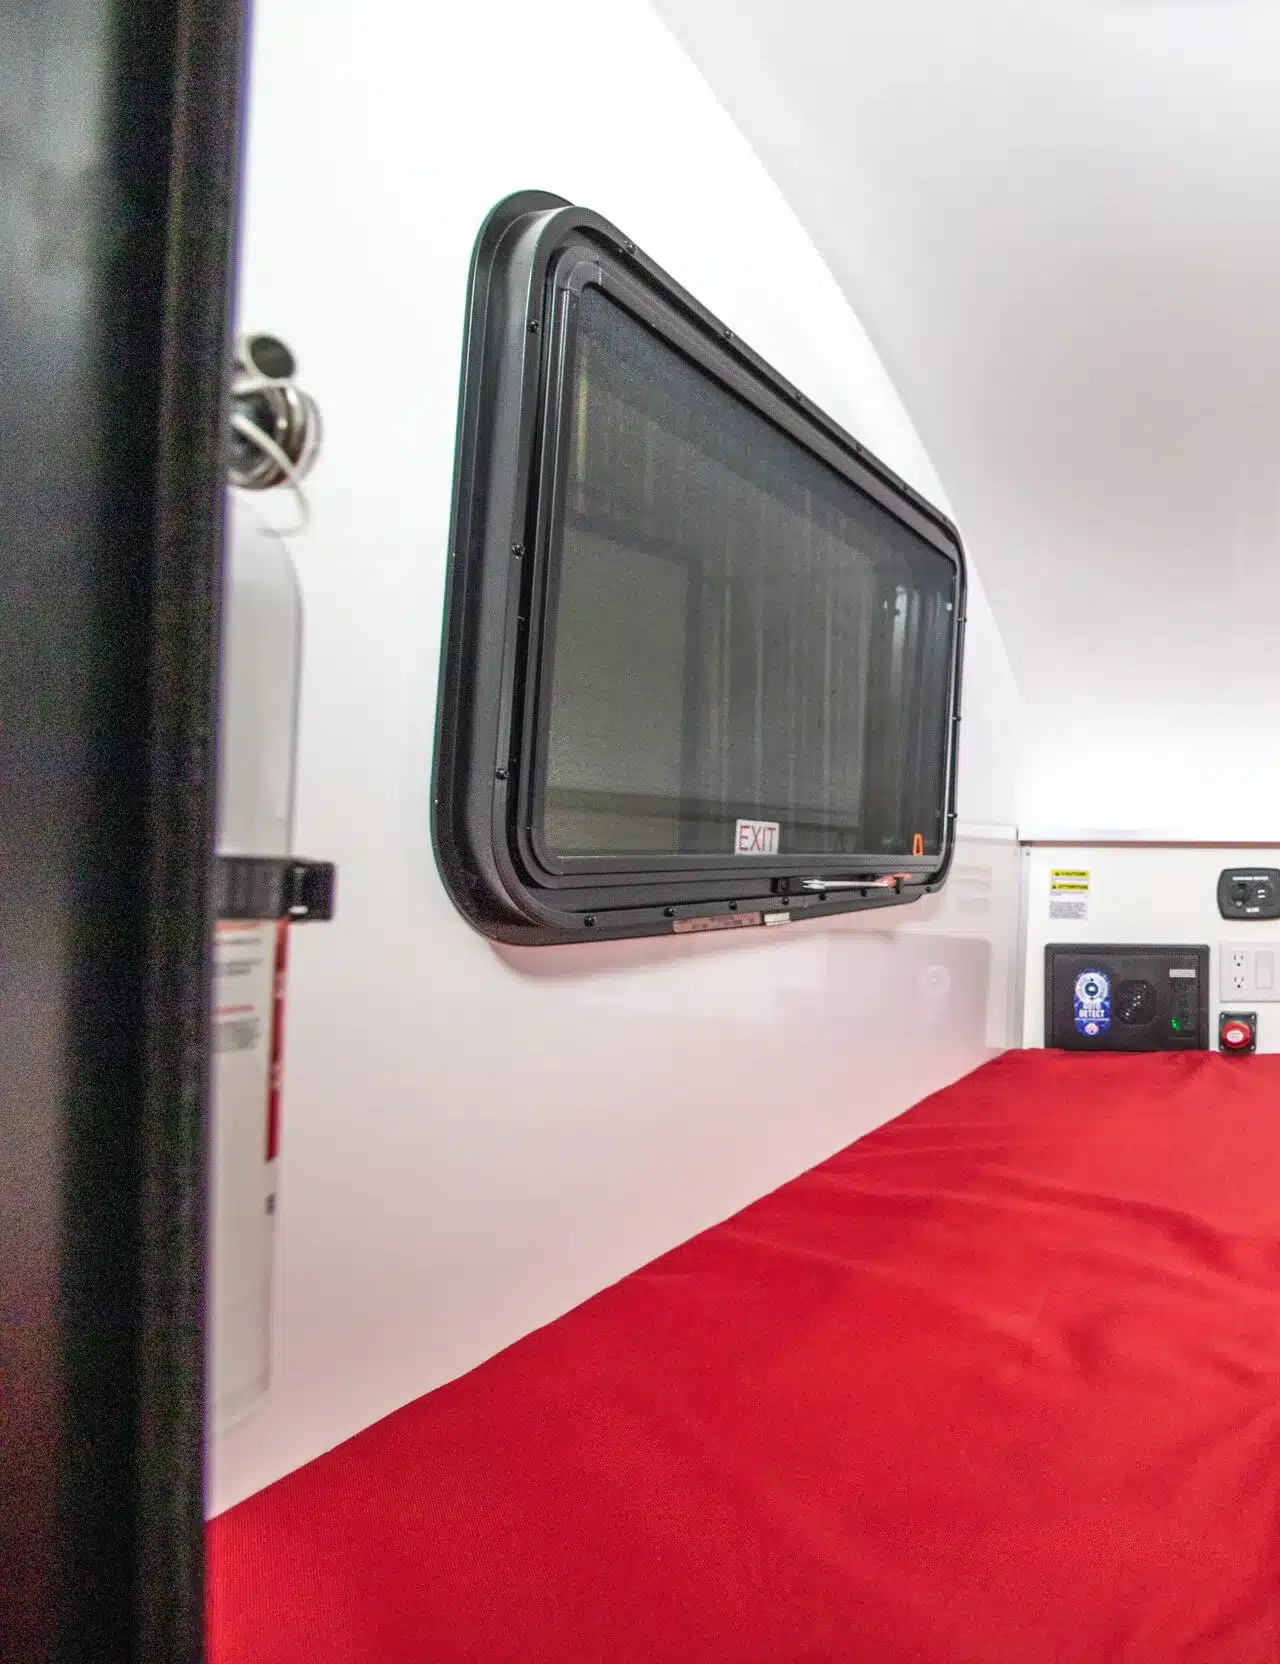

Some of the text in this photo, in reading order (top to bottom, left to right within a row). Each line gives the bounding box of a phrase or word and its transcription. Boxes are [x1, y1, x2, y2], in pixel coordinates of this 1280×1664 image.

[739, 825, 776, 851] EXIT
[1083, 1001, 1101, 1009] AUTO
[1079, 1009, 1105, 1018] DETECT
